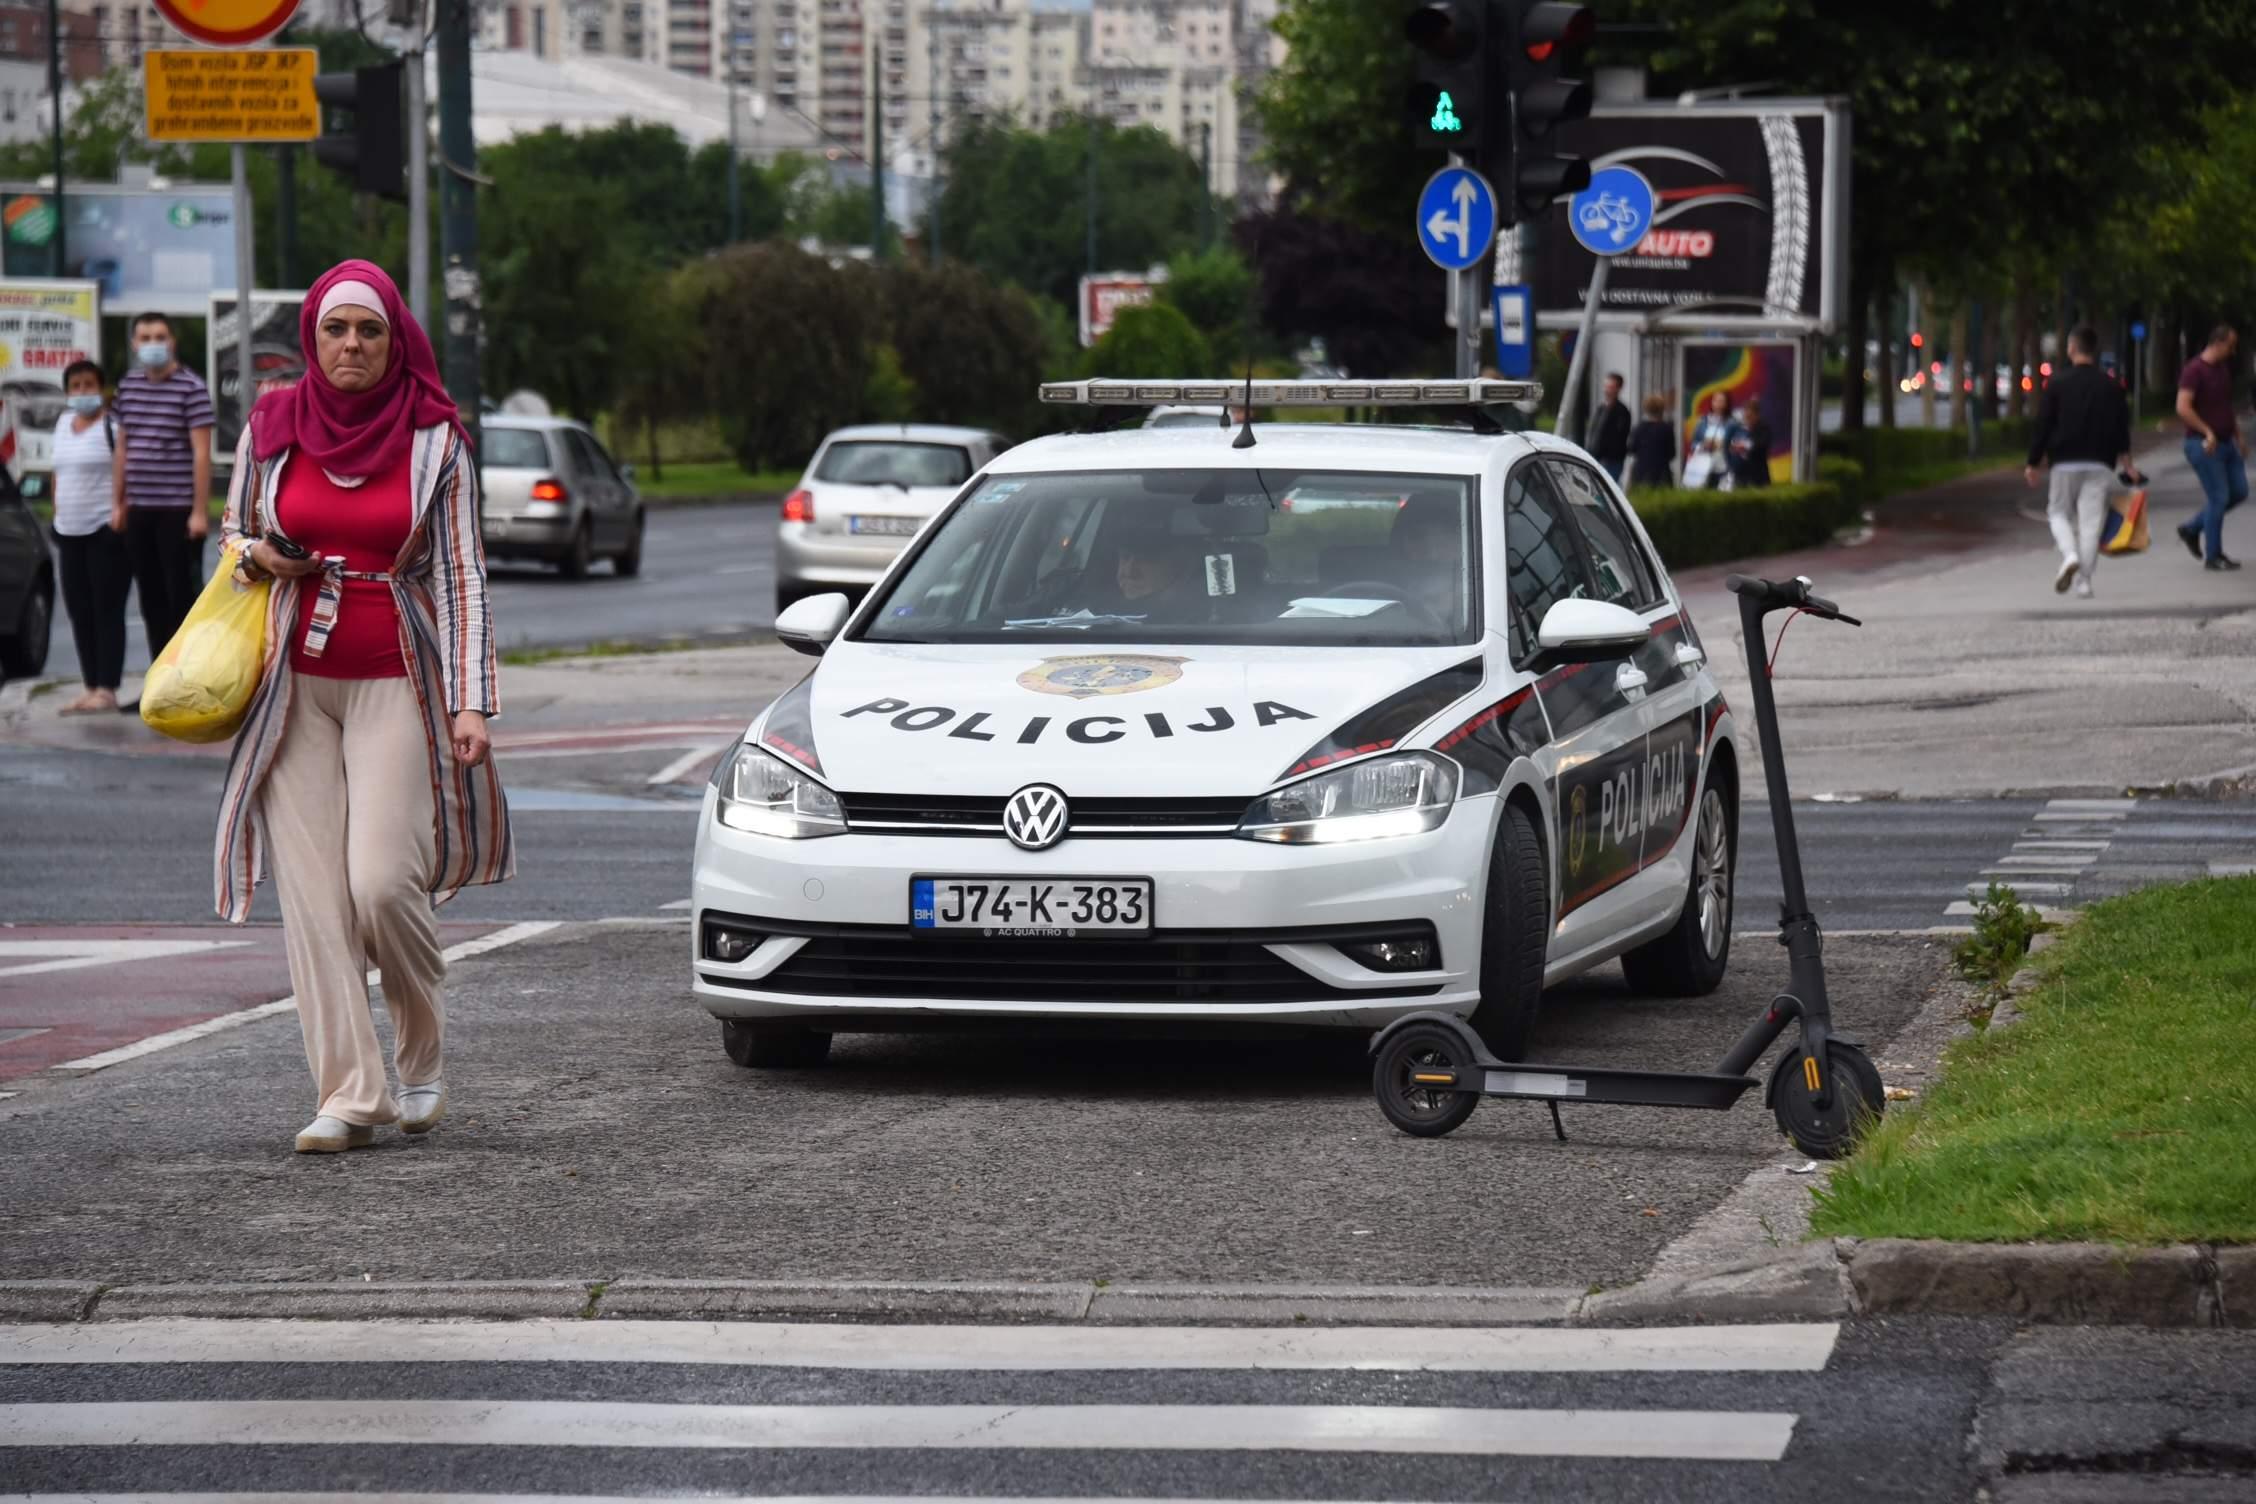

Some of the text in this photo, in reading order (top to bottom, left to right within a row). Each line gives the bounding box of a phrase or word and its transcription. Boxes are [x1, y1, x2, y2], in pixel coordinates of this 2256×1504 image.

[840, 697, 1319, 745] POLICIJA
[1598, 740, 1686, 853] POLICIJA
[914, 909, 934, 920] BIH
[941, 885, 1143, 924] J74-K-383
[998, 928, 1062, 937] AC QUATTRO
